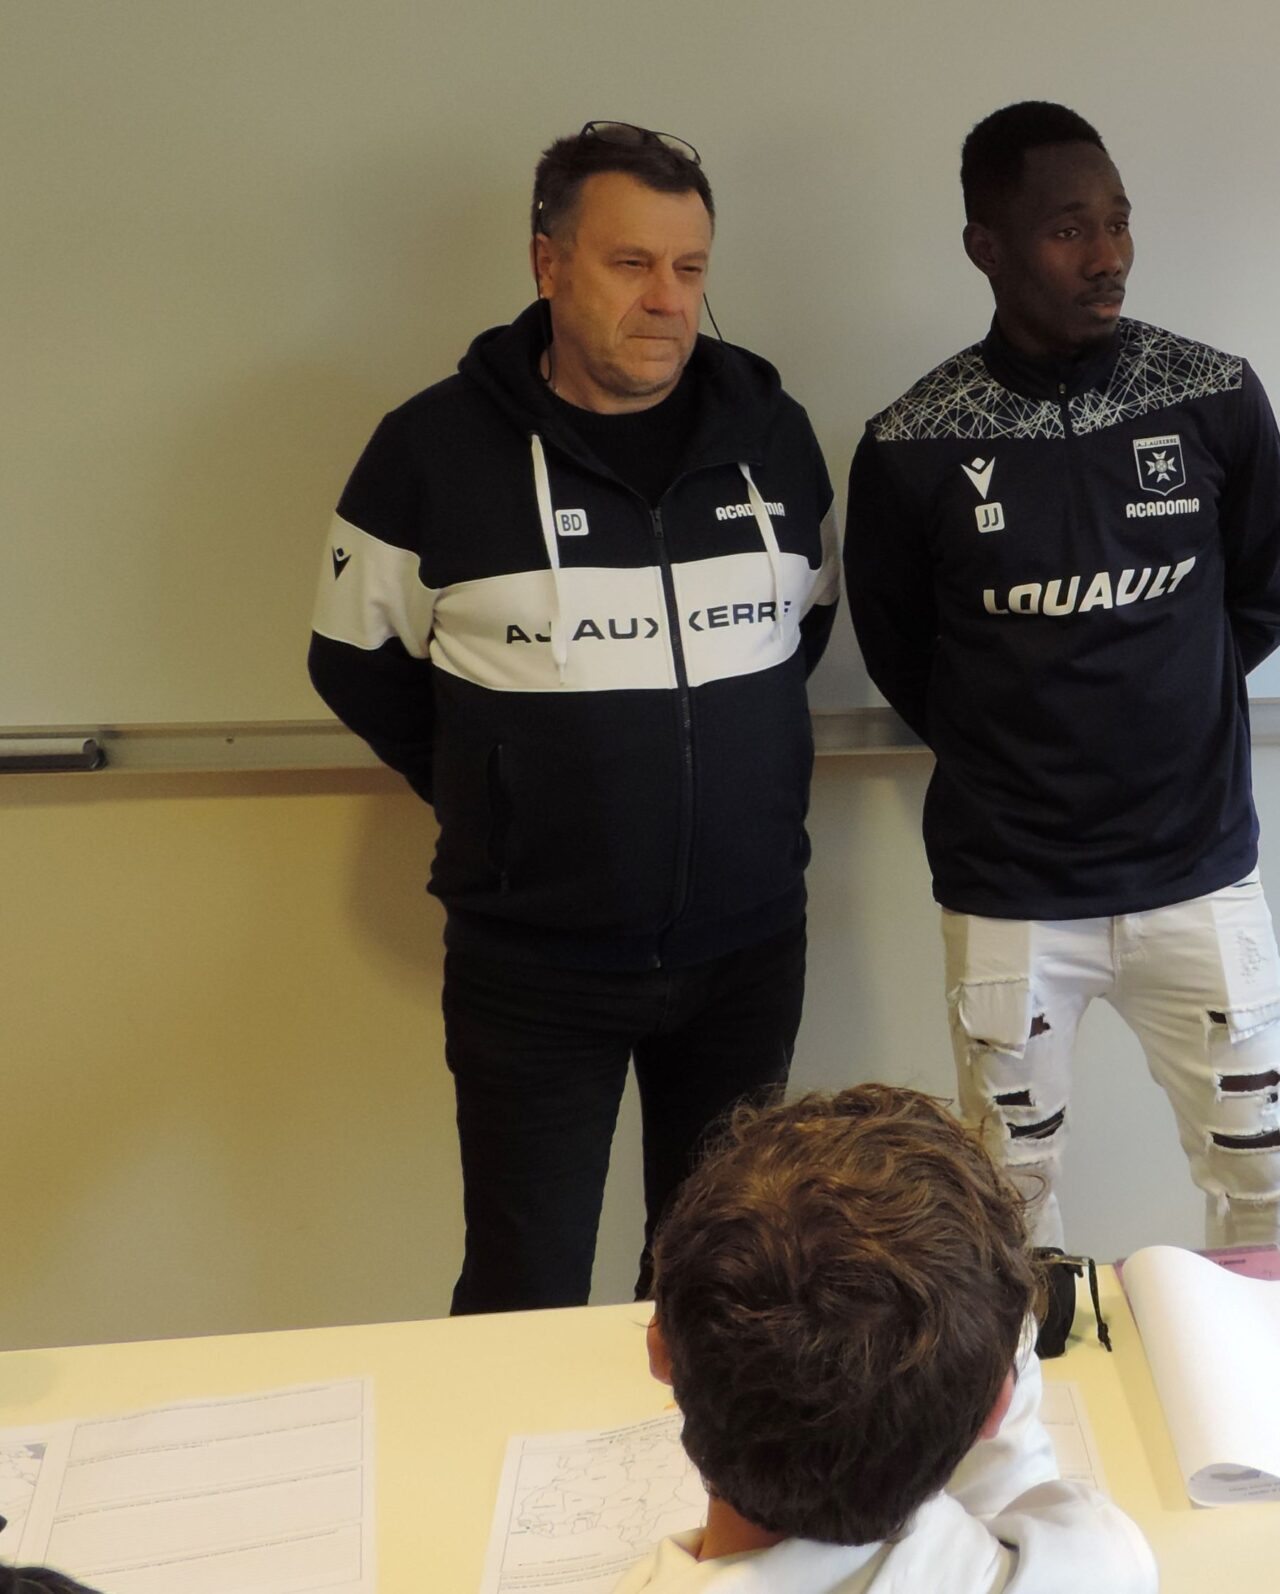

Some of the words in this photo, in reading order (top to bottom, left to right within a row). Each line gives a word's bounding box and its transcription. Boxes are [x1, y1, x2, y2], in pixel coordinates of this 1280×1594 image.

[715, 502, 786, 521] ACADMIA
[982, 507, 1000, 528] JJ
[1125, 498, 1200, 518] ACADOMIA
[560, 513, 583, 532] BD
[983, 556, 1196, 616] LOUAULT
